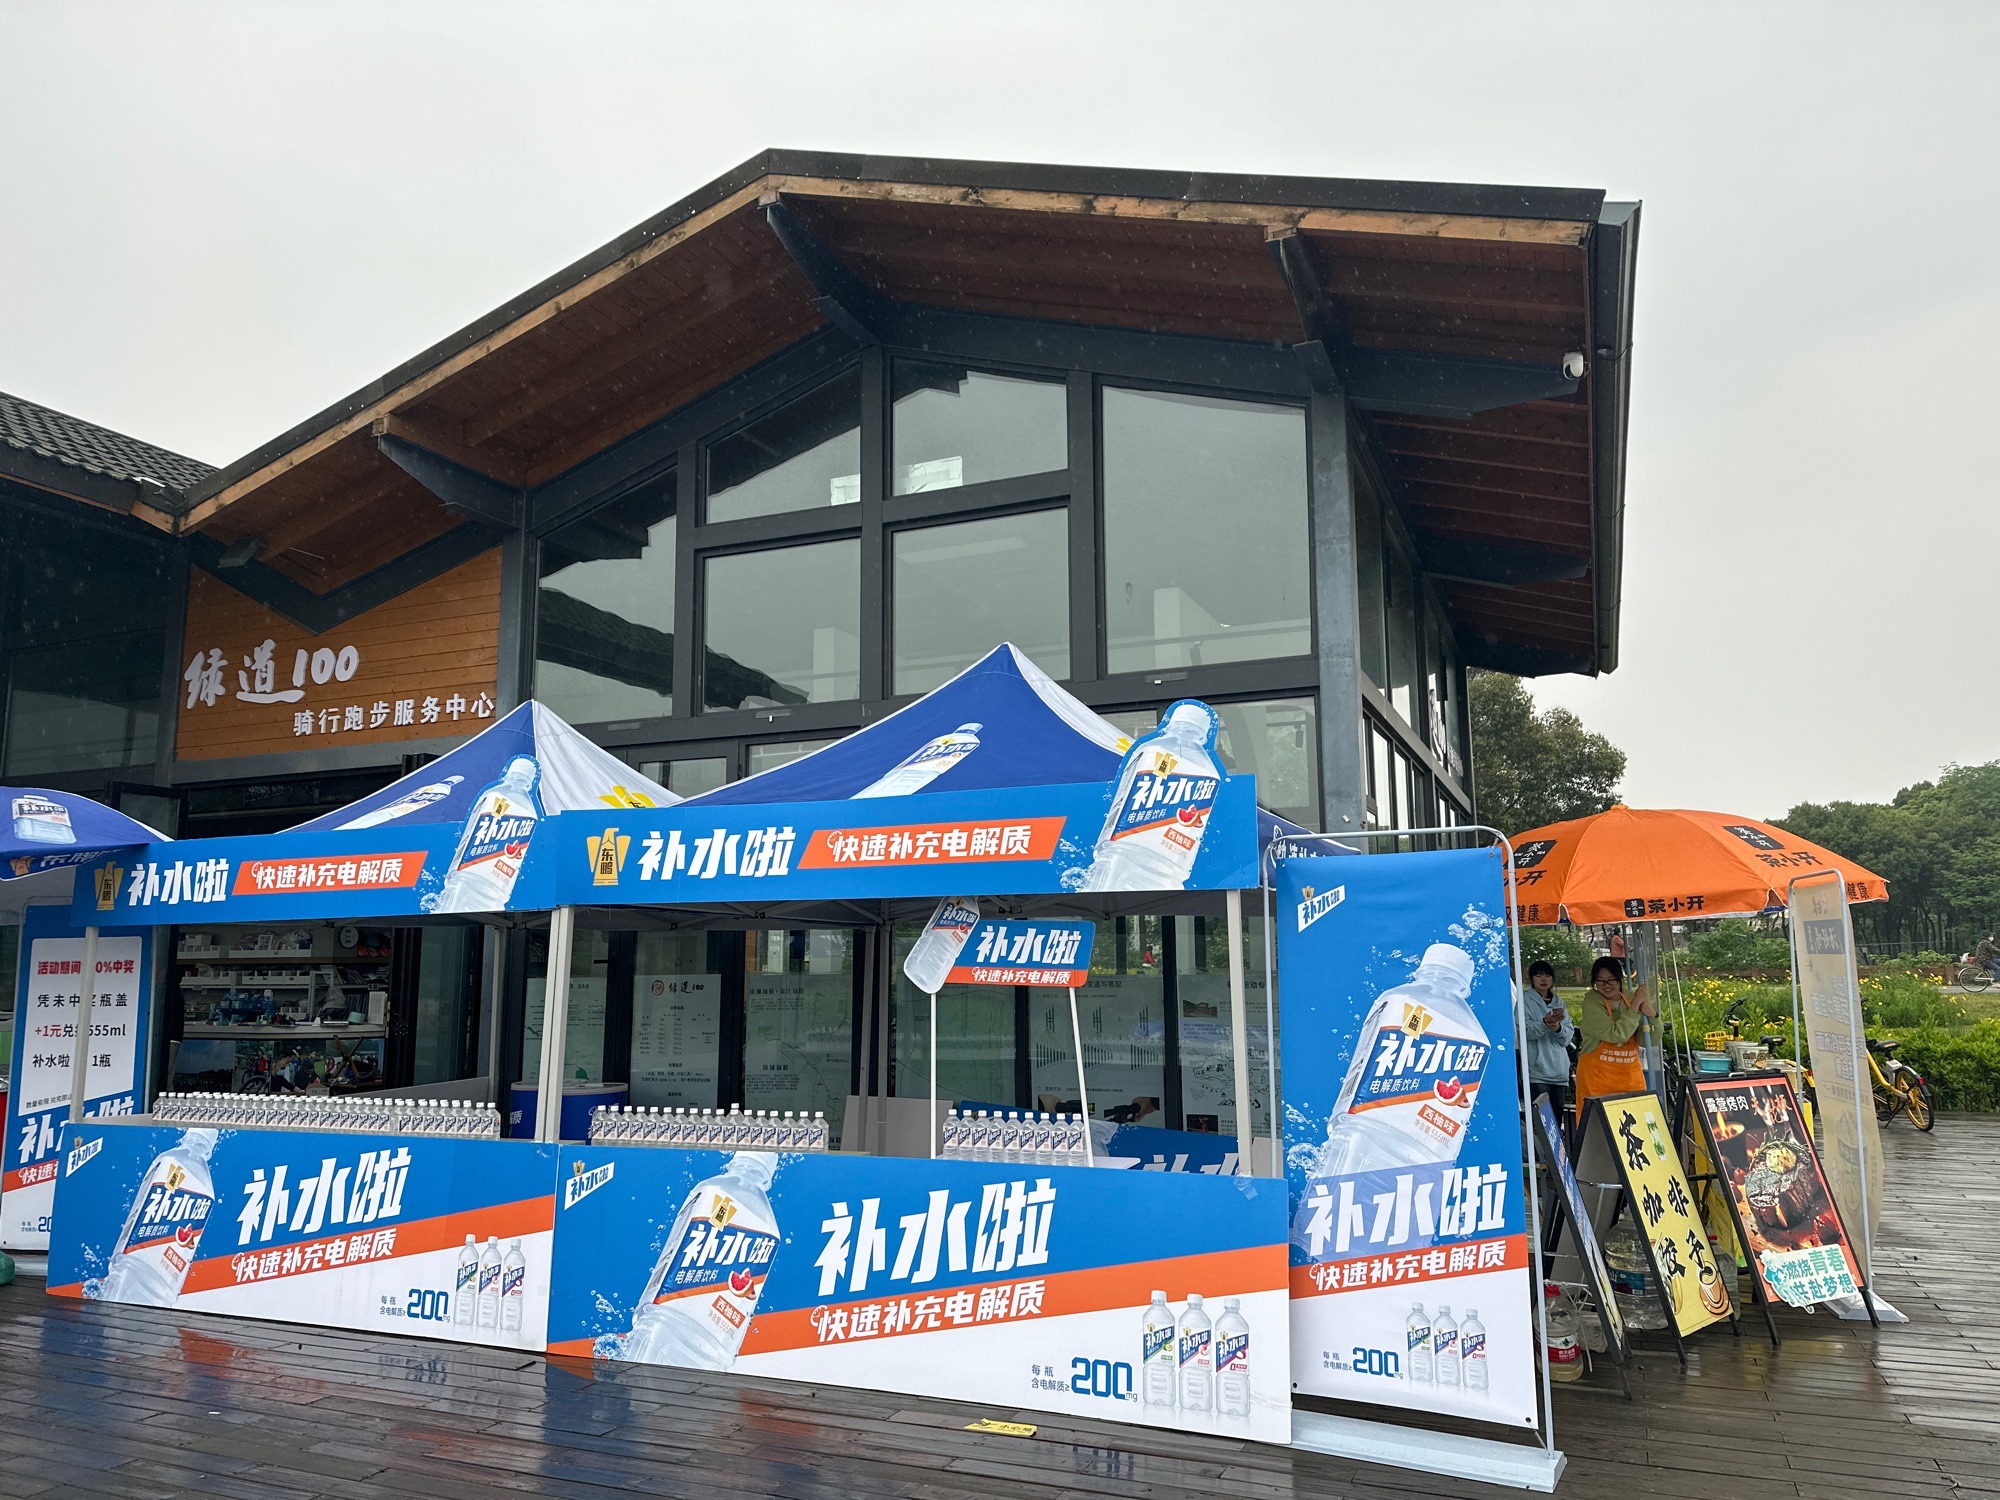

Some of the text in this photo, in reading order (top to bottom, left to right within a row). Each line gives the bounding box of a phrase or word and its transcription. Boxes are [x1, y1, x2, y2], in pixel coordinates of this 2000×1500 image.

[183, 638, 359, 709] 绿道100
[293, 691, 496, 737] 骑行跑步服务中心
[1132, 776, 1216, 810] 补水啦
[474, 816, 534, 845] 补水啦
[1127, 808, 1167, 823] 电解质饮料
[637, 826, 797, 881] 补水啦
[834, 825, 1033, 863] 快速补充电解质
[1755, 851, 1823, 868] 茶小开
[256, 857, 403, 890] 快速补充电解质
[600, 848, 615, 875] 东鹏
[127, 858, 230, 906] 补水啦
[943, 904, 978, 923] 补水啦
[1302, 889, 1340, 924] 补水啦
[1648, 896, 1705, 913] 茶小开
[976, 925, 1082, 964] 补水啦
[37, 961, 82, 975] 活动期间
[973, 969, 1072, 985] 快速补充电解质
[32, 1054, 112, 1068] 补水啦 1瓶
[1375, 1033, 1486, 1077] 补水啦
[1369, 1078, 1421, 1095] 电解质饮料
[1705, 1095, 1749, 1113] 露营烤肉
[1423, 1107, 1457, 1135] 西柚味
[71, 1141, 99, 1170] 补水啦
[1618, 1110, 1650, 1172] 茶
[236, 1146, 412, 1246] 补水啦
[570, 1166, 610, 1202] 补水啦
[143, 1188, 211, 1224] 补水啦
[1304, 1163, 1508, 1257] 补水啦
[1641, 1174, 1690, 1228] 咖啡
[138, 1224, 170, 1238] 电解质饮料
[681, 1224, 776, 1268] 补水啦
[814, 1178, 1057, 1297] 补水啦
[236, 1227, 398, 1283] 快速补充电解质
[1315, 1240, 1507, 1292] 快速补充电解质
[1782, 1248, 1845, 1280] 燃烧青春
[674, 1268, 718, 1284] 电解质饮料
[1790, 1272, 1857, 1300] 共赴梦想
[381, 1295, 397, 1306] 每瓶
[715, 1297, 742, 1326] 西柚味
[817, 1279, 1046, 1342] 快速补充电解质
[1031, 1364, 1054, 1378] 每瓶
